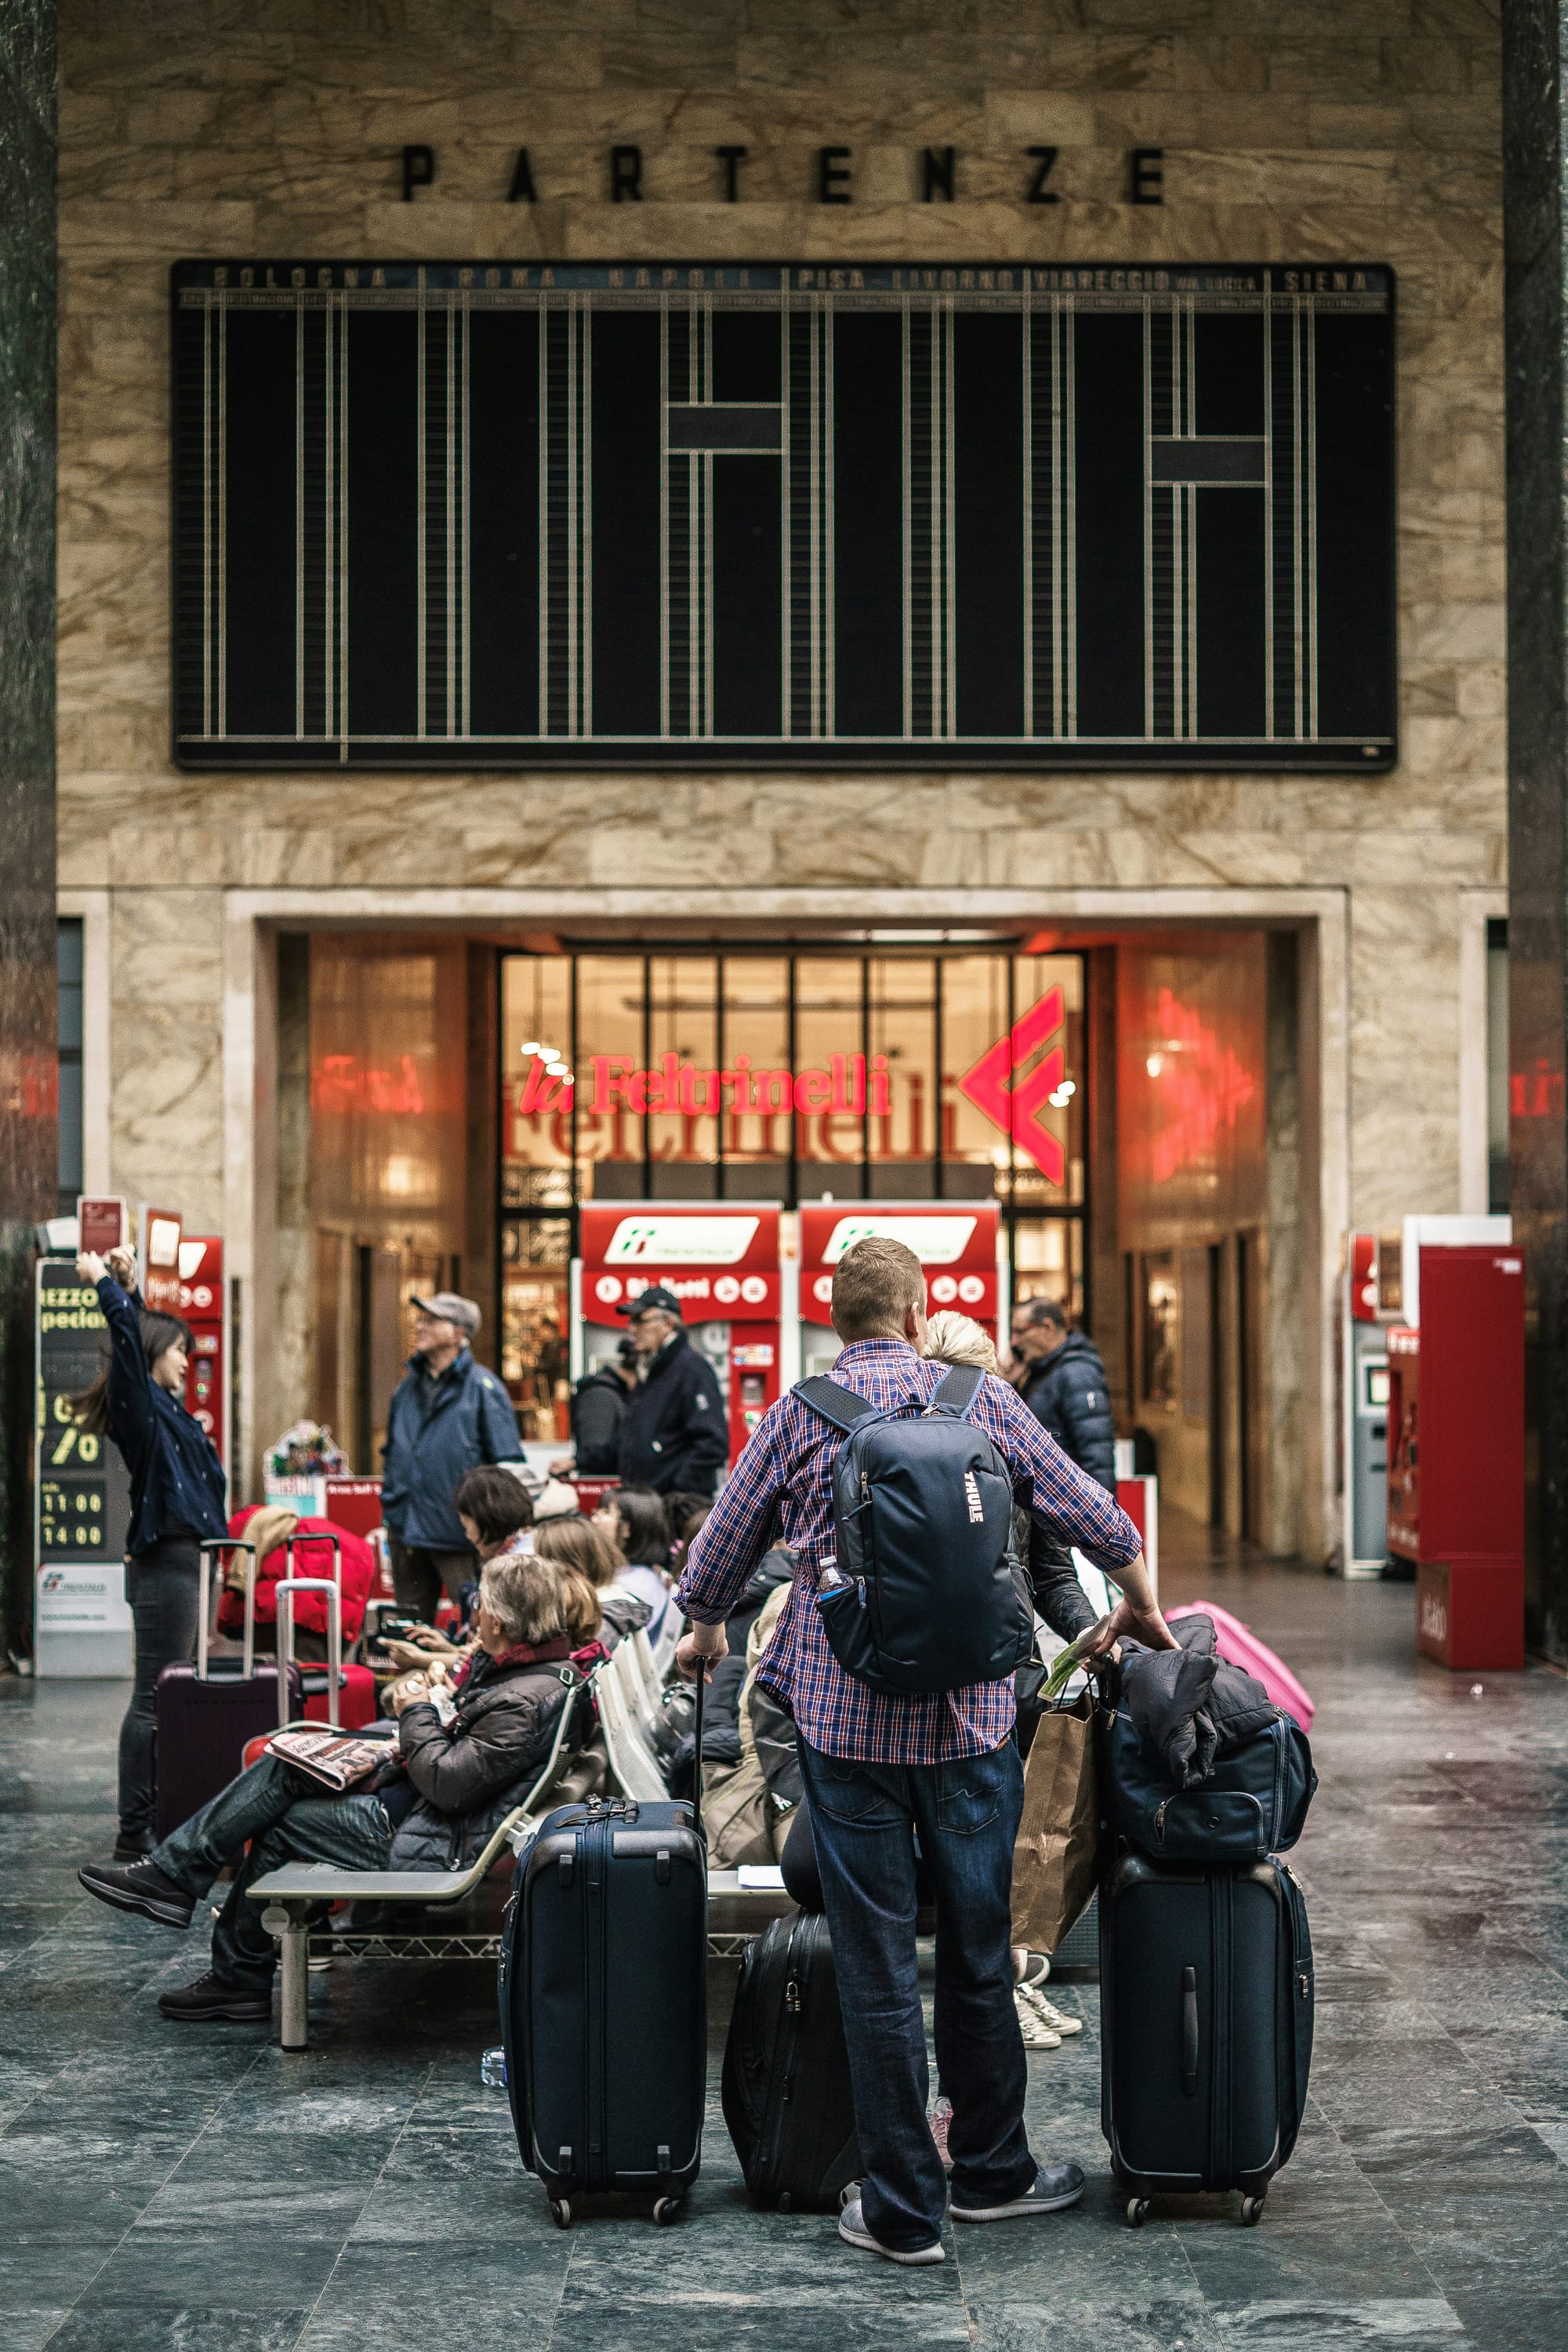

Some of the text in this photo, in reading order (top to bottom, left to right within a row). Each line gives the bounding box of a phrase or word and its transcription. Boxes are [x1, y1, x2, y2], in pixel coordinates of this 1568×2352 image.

[402, 145, 1163, 205] PARTENZE
[214, 267, 387, 288] BOLOGNA
[459, 267, 555, 289] ROMA
[608, 268, 750, 289] NAPOLI
[799, 269, 862, 289] PISA
[891, 269, 1013, 289] LIVORNO
[1035, 270, 1168, 290] VIAREGGIO
[1284, 270, 1367, 291] SIENA
[519, 1049, 892, 1116] la Feltrinelli
[626, 1276, 710, 1300] Bilietti
[964, 1471, 984, 1523] THULE
